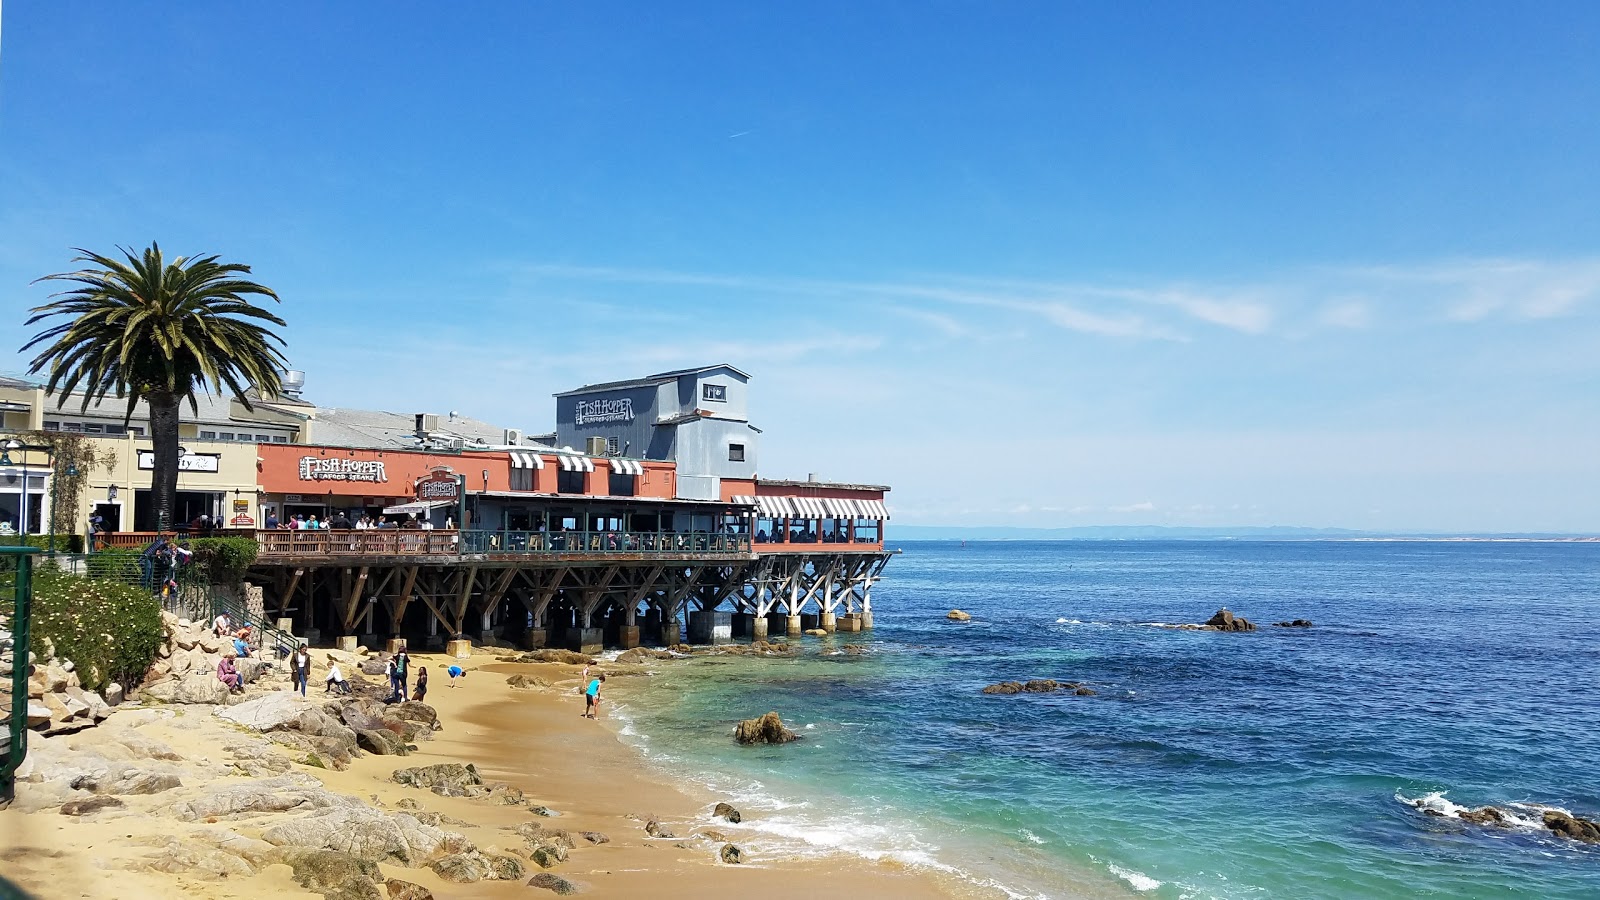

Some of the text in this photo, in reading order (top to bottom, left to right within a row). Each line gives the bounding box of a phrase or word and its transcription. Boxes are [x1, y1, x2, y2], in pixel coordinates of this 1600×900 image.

[578, 398, 635, 424] FISH HOPPER
[304, 456, 388, 482] FISH HOPPER
